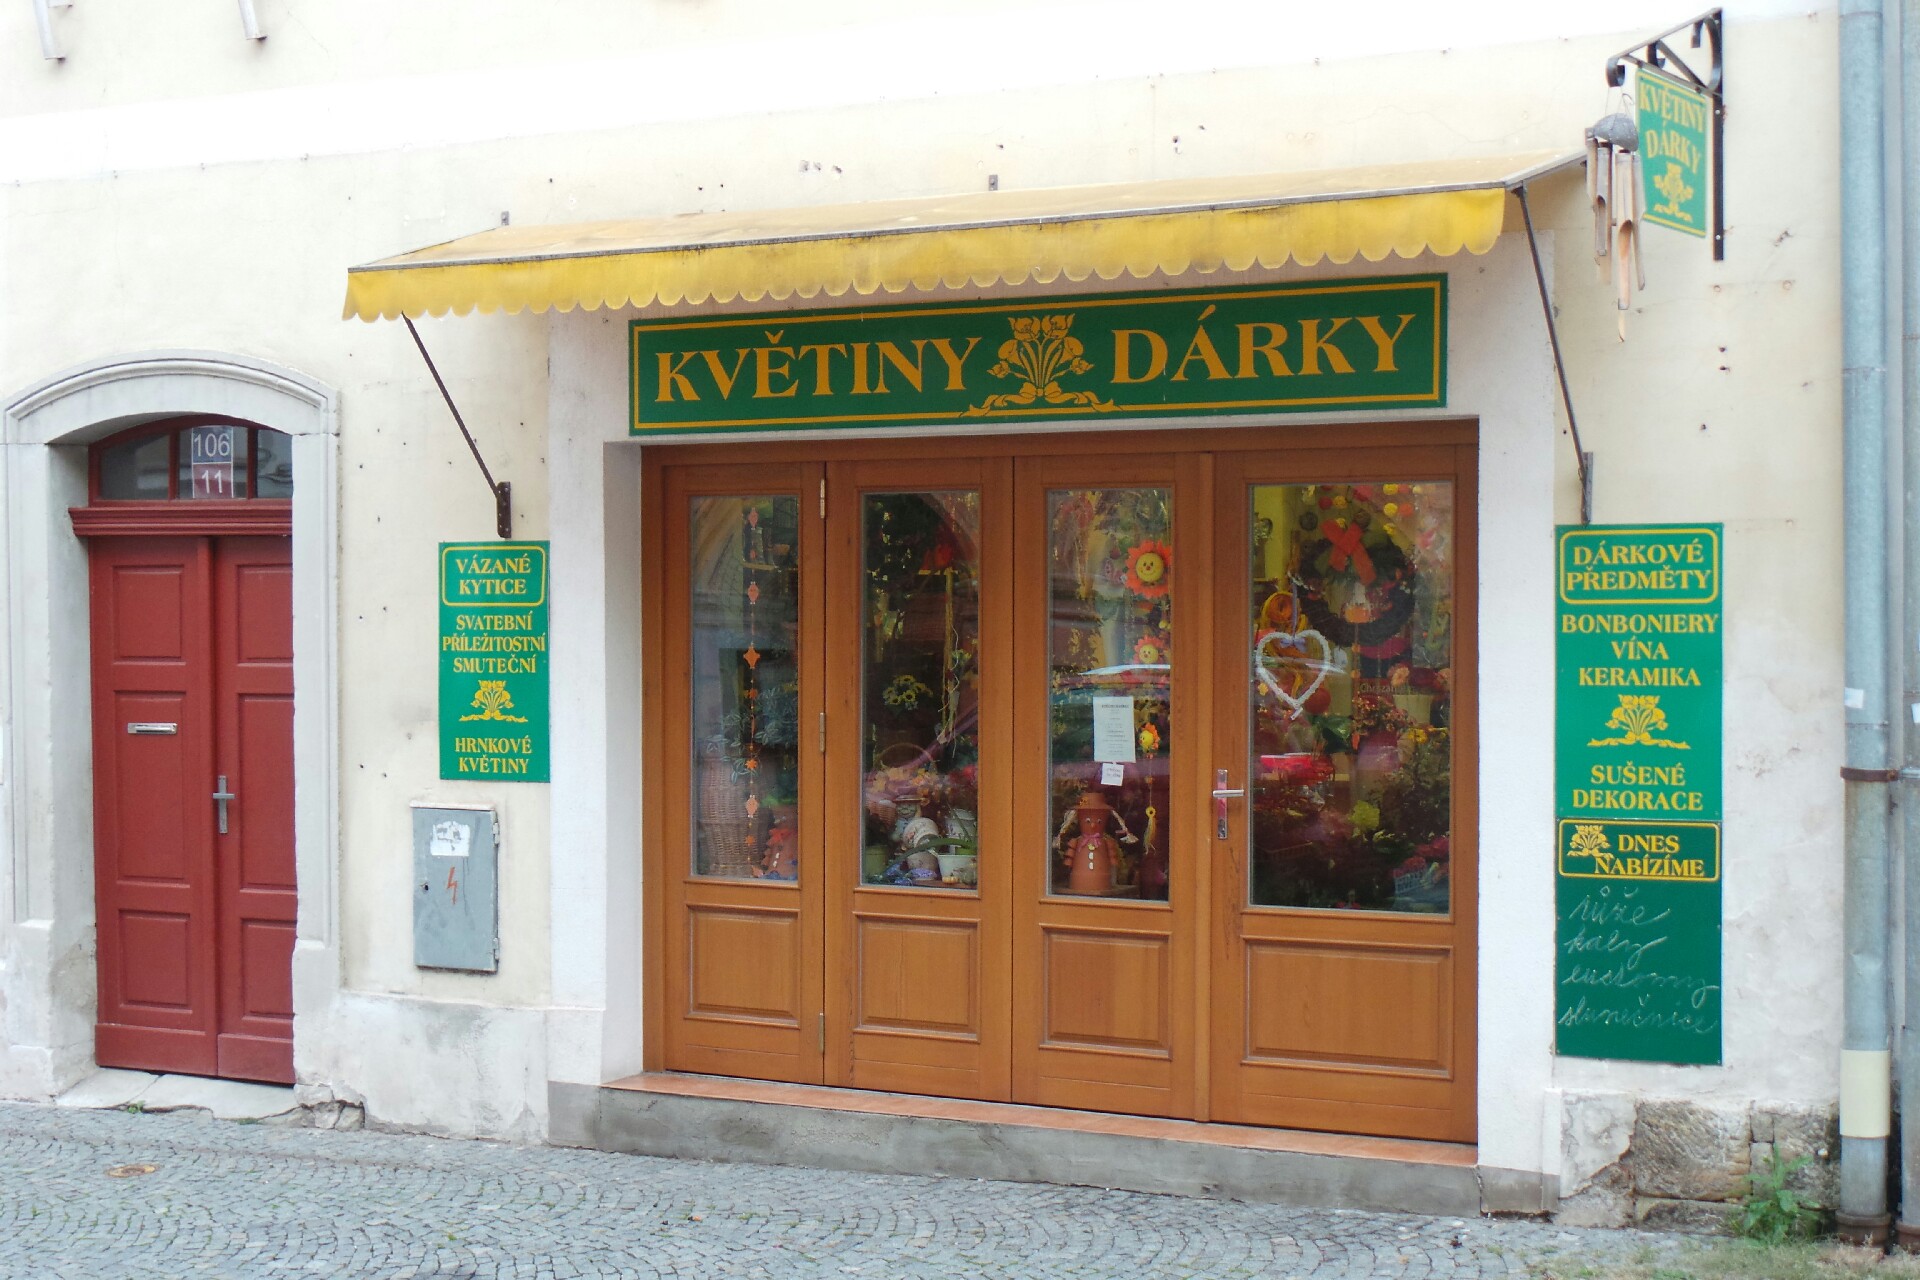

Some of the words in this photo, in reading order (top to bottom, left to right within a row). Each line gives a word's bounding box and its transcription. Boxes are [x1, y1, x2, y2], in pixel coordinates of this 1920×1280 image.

[1639, 82, 1706, 133] KVĚTINY
[1645, 120, 1701, 174] DÁRKY
[653, 329, 982, 403] KVĚTINY
[1109, 304, 1417, 385] DÁRKY
[193, 432, 231, 457] 106
[202, 469, 224, 494] 11
[1573, 538, 1704, 566] DÁRKOVÉ
[455, 554, 531, 574] VÁZANÉ
[459, 578, 527, 595] KYTICE
[1566, 565, 1712, 592] PŘEDMĚTY
[456, 611, 532, 631] SVATEBNÍ
[1562, 613, 1718, 634] BONBONIERY
[443, 632, 545, 652] PŘÍLEŽITOSTNÍ
[1611, 636, 1669, 660] VÍNA
[453, 654, 536, 673] SMUTEČNÍ
[1579, 667, 1701, 687] KERAMIKA
[455, 735, 532, 754] HRNKOVÉ
[458, 756, 529, 774] KVĚTINY
[1591, 761, 1686, 786] SUŠENÉ
[1572, 789, 1703, 811] DEKORACE
[1618, 834, 1680, 854] DNES
[1595, 855, 1705, 878] NABÍZÍME
